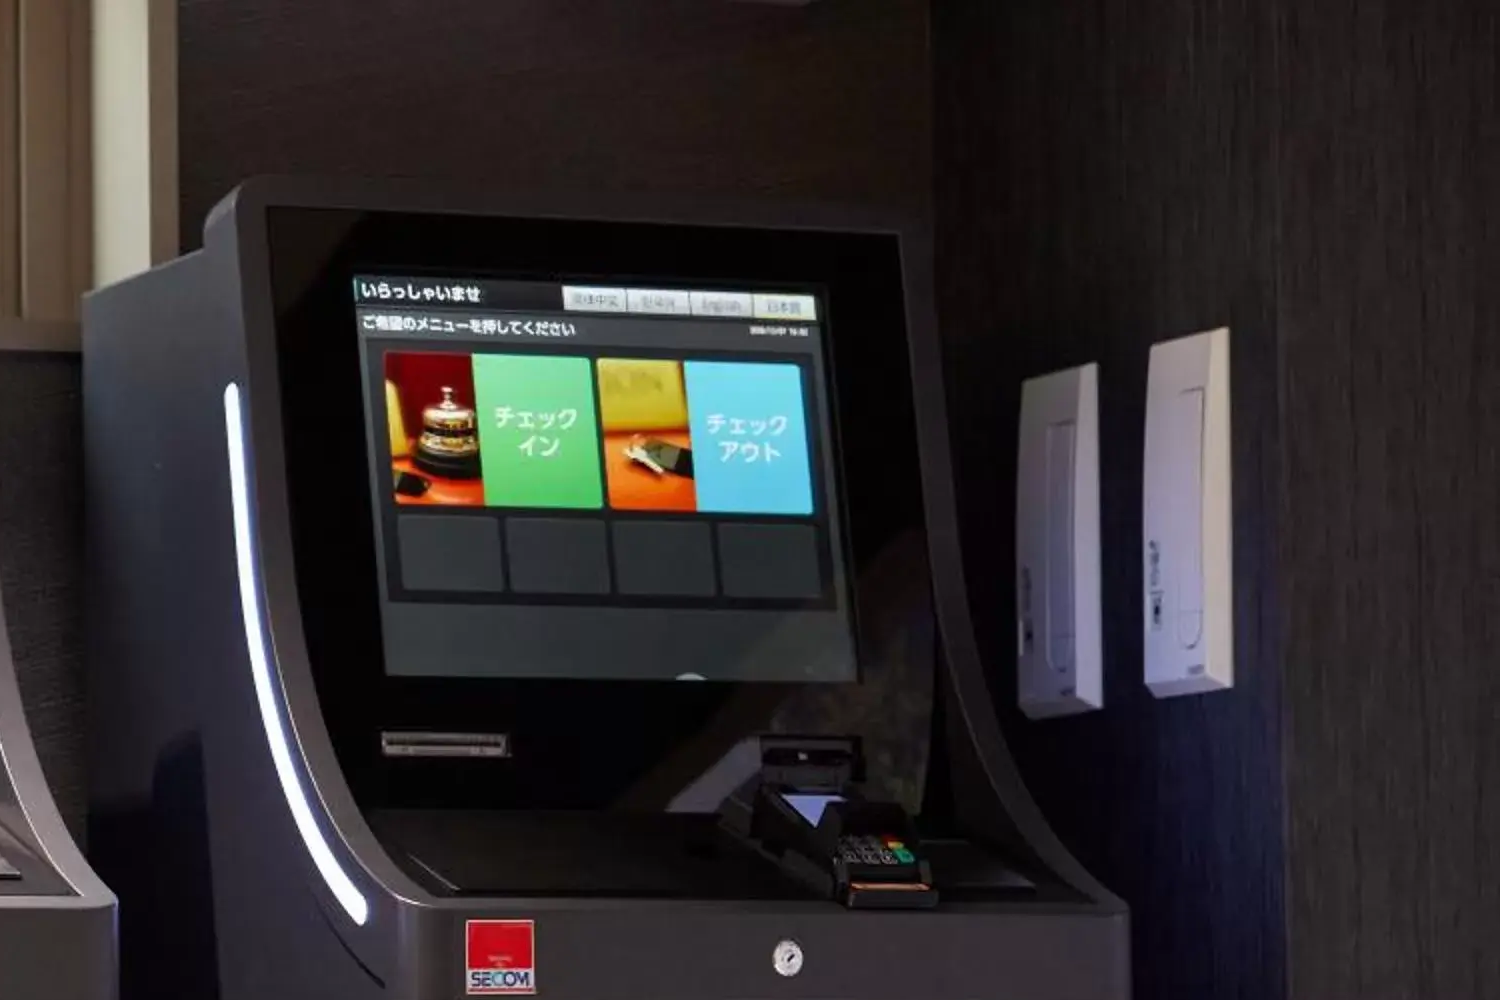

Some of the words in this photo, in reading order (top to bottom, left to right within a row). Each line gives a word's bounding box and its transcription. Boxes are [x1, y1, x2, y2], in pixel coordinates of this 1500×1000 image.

[361, 282, 481, 303] いらっしゃいませ
[362, 314, 576, 337] ご希望のメニューを押してください
[493, 405, 578, 432] チェック
[706, 412, 789, 438] チェック
[518, 434, 561, 458] イン
[718, 439, 783, 464] アウト
[471, 971, 530, 987] SECOM
